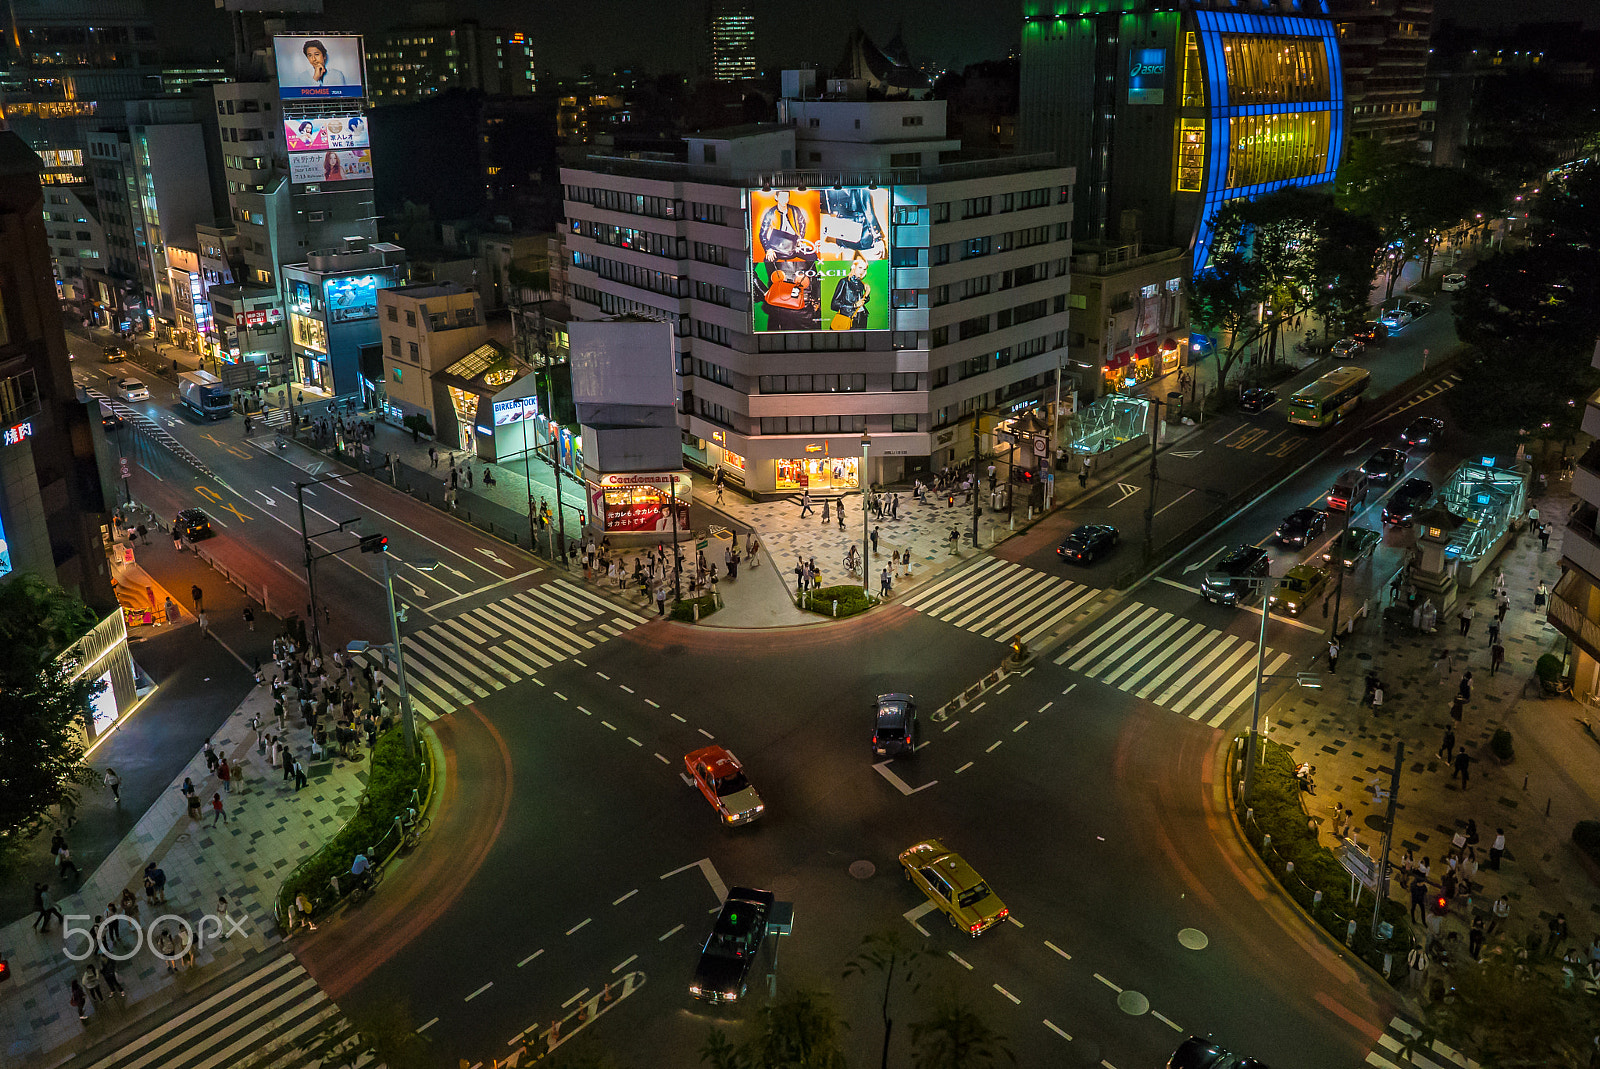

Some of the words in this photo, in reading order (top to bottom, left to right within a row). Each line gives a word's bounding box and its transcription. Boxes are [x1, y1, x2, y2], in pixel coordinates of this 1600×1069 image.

[795, 269, 847, 277] COACH
[494, 397, 536, 412] BIRKENSOCK
[1011, 400, 1029, 412] LOUIS
[609, 473, 681, 484] Condomania
